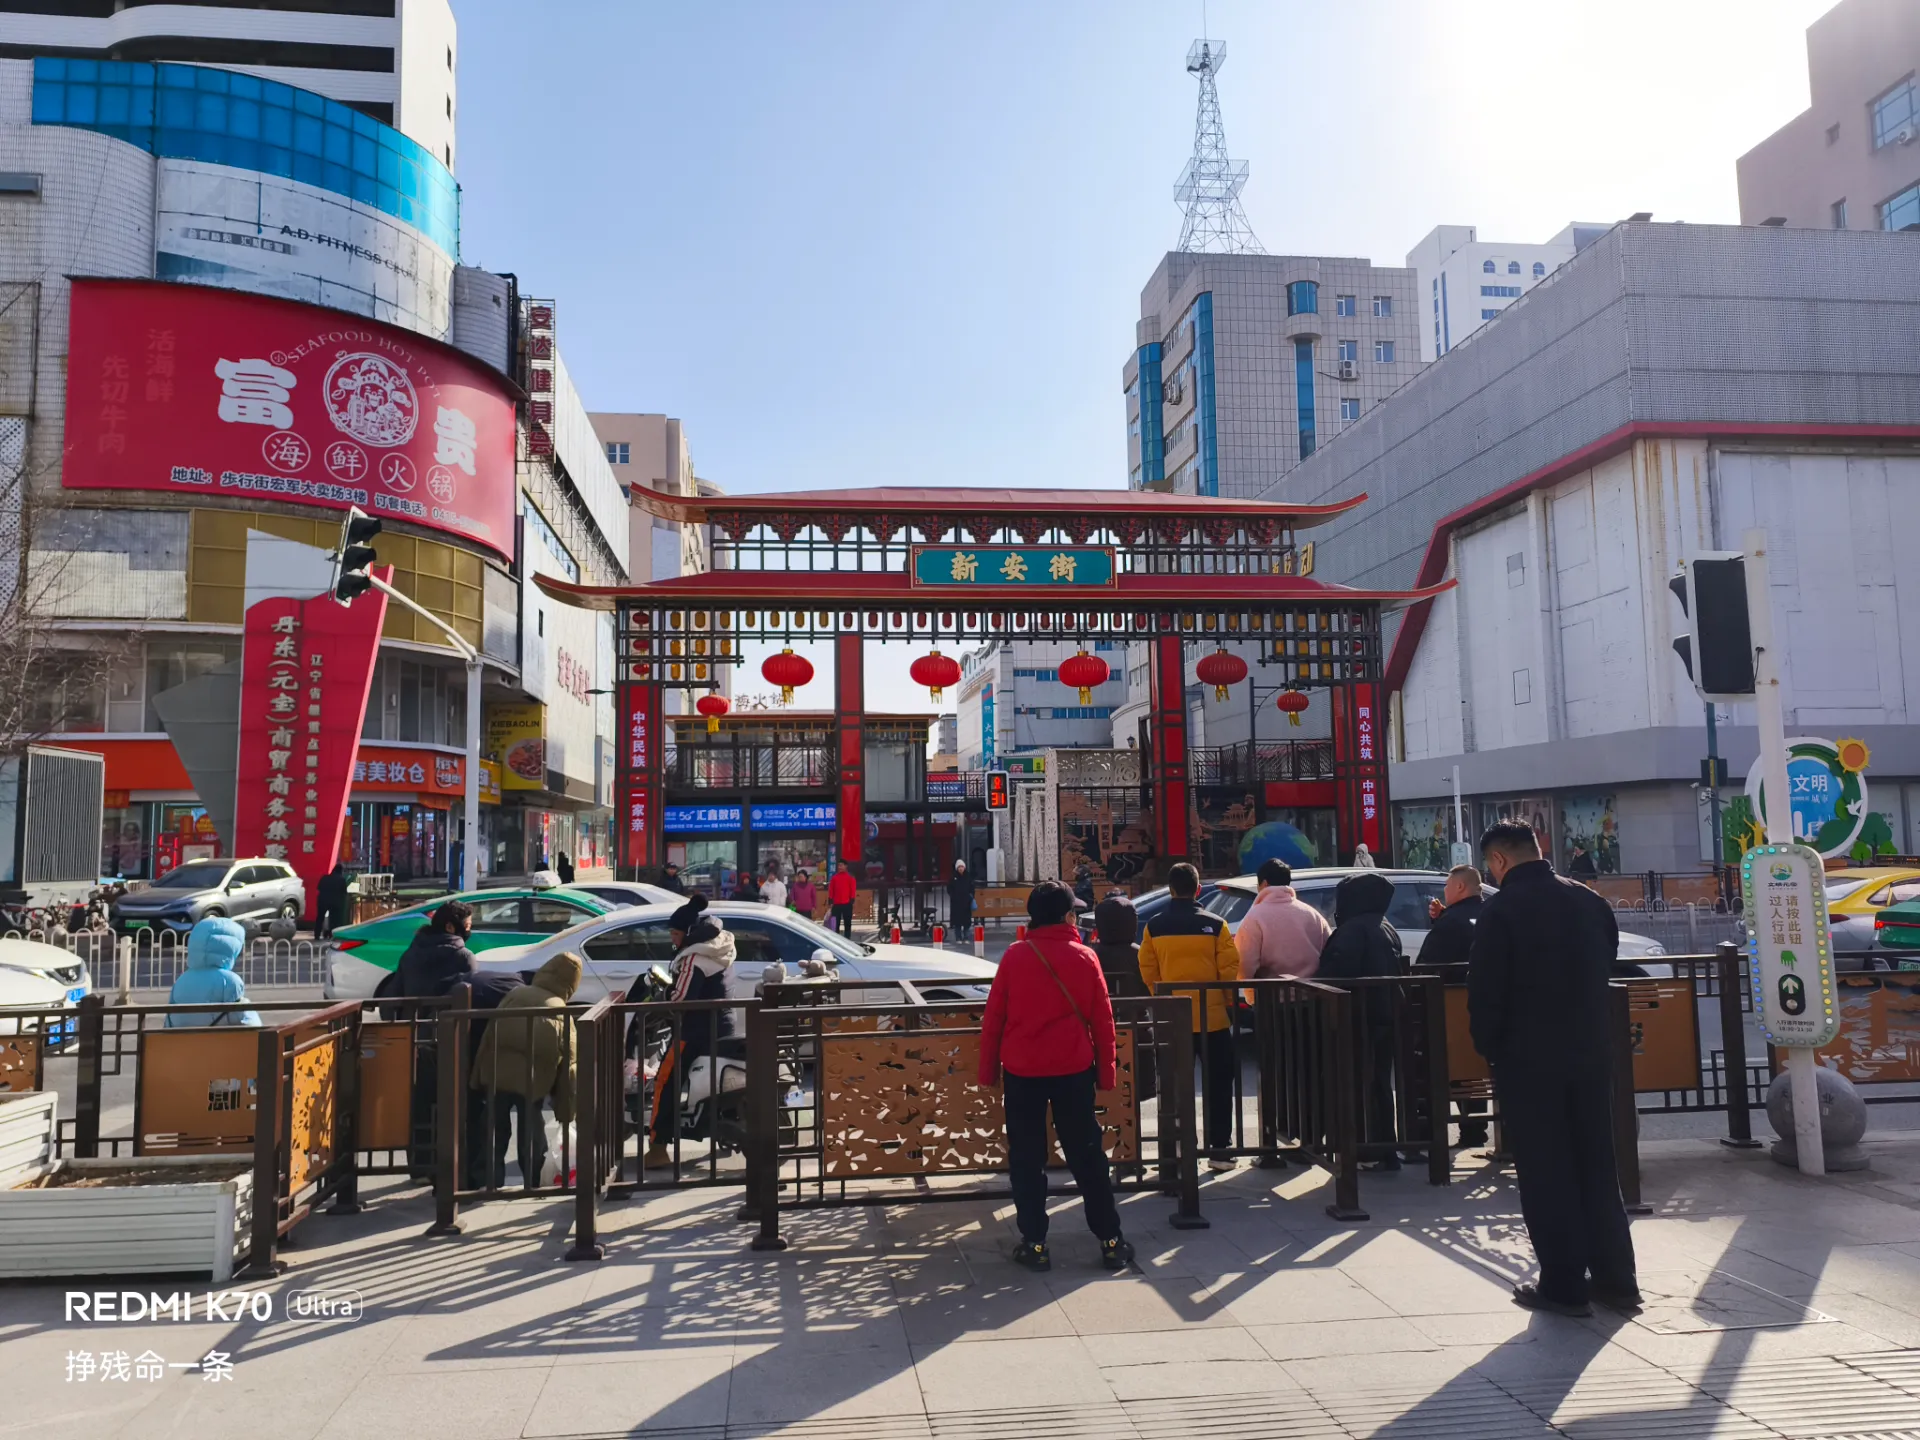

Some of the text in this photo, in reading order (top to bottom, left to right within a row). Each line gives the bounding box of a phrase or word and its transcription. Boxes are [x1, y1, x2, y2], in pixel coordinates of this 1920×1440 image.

[317, 231, 382, 265] FITNESS
[287, 331, 374, 364] SEAFOOD
[378, 336, 417, 364] HOT
[270, 436, 453, 499] 海鲜火锅
[951, 551, 1078, 583] 新安街
[491, 719, 540, 729] XIEBAOLIN
[631, 711, 645, 832] 中华民族 一家亲
[1359, 707, 1375, 820] 同心共筑 中国梦
[991, 792, 1005, 806] 31
[1788, 774, 1829, 794] 文明
[697, 809, 740, 820] 汇鑫数码
[1769, 895, 1785, 945] 过人行道
[1786, 895, 1803, 945] 请按此钮
